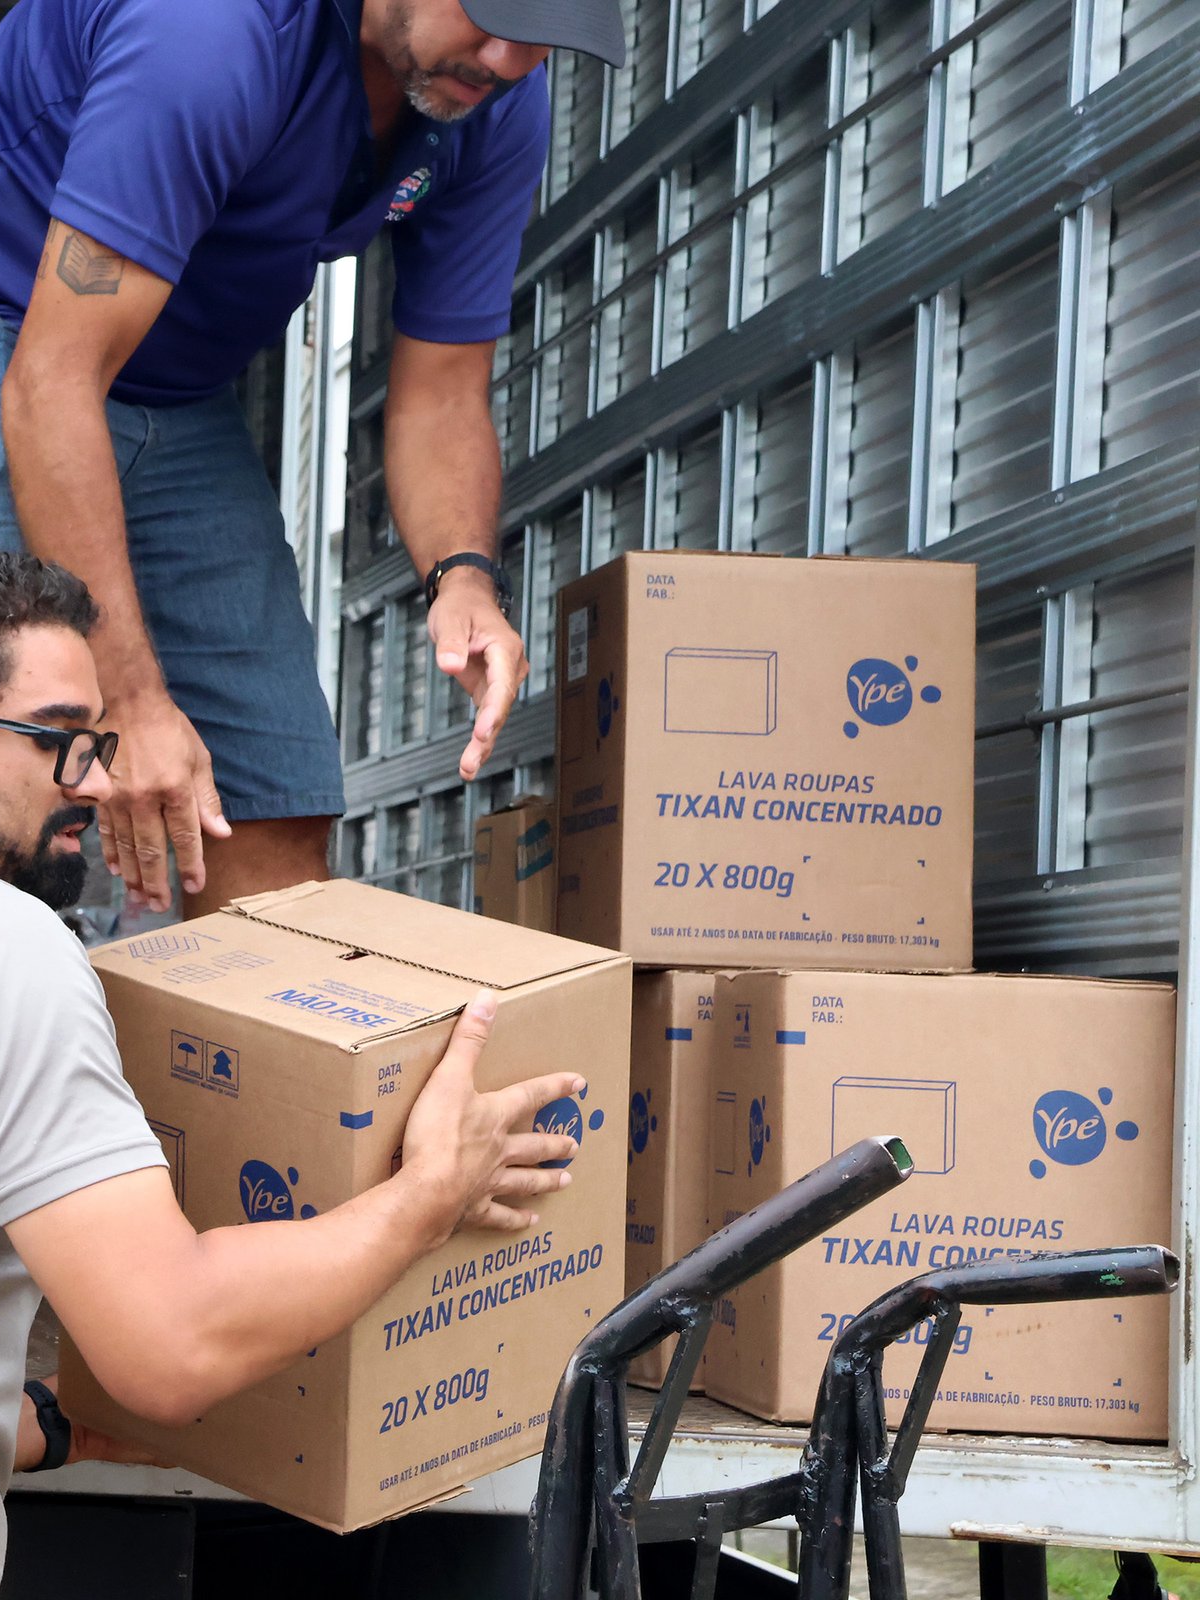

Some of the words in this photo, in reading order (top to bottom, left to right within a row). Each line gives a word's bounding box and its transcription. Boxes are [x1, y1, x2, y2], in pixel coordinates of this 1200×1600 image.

[646, 574, 676, 586] DATA
[718, 770, 777, 791] LAVA
[783, 773, 875, 794] ROUPAS
[655, 794, 746, 820] TIXAN
[753, 799, 942, 827] CONCENTRADO
[654, 862, 689, 888] 20
[695, 863, 719, 888] X
[723, 864, 795, 897] 800g
[651, 927, 674, 937] USAR
[676, 925, 692, 937] ATÉ
[694, 929, 700, 938] 2
[702, 928, 725, 939] ANOS
[727, 929, 740, 939] DA
[742, 930, 764, 940] DATA
[766, 931, 777, 941] DE
[779, 930, 833, 944] FABRICAÇÃO
[841, 933, 864, 944] PESO
[866, 934, 897, 945] BRUTO:
[929, 937, 940, 948] kg
[272, 989, 337, 1011] NÃO
[333, 1006, 397, 1028] PISE
[698, 995, 714, 1006] DA
[812, 996, 844, 1008] DATA
[812, 1011, 843, 1024] FAB.:
[378, 1062, 402, 1081] DATA
[891, 1213, 954, 1235] LAVA
[963, 1216, 1064, 1240] ROUPAS
[432, 1260, 477, 1297] LAVA
[481, 1231, 553, 1277] ROUPAS
[822, 1237, 921, 1267] TIXAN
[383, 1298, 453, 1351] TIXAN
[458, 1244, 603, 1321] CONCENTRADO
[379, 1396, 408, 1434] 20
[412, 1384, 431, 1421] X
[433, 1368, 489, 1411] 800g
[946, 1391, 958, 1402] DE
[961, 1391, 1020, 1406] FABRICAÇÃO
[1030, 1395, 1055, 1406] PESO
[1058, 1396, 1092, 1408] BRUTO:
[1095, 1398, 1126, 1411] 17,303
[1128, 1399, 1140, 1413] kg
[380, 1474, 399, 1491] USAR
[400, 1466, 413, 1481] ATÉ
[414, 1467, 419, 1477] 2
[420, 1457, 439, 1473] ANOS
[440, 1454, 450, 1466] DA
[451, 1447, 469, 1462] DATA
[470, 1442, 479, 1453] DE
[480, 1421, 521, 1449] FABRICAÇÃO
[528, 1414, 546, 1429] PESO
